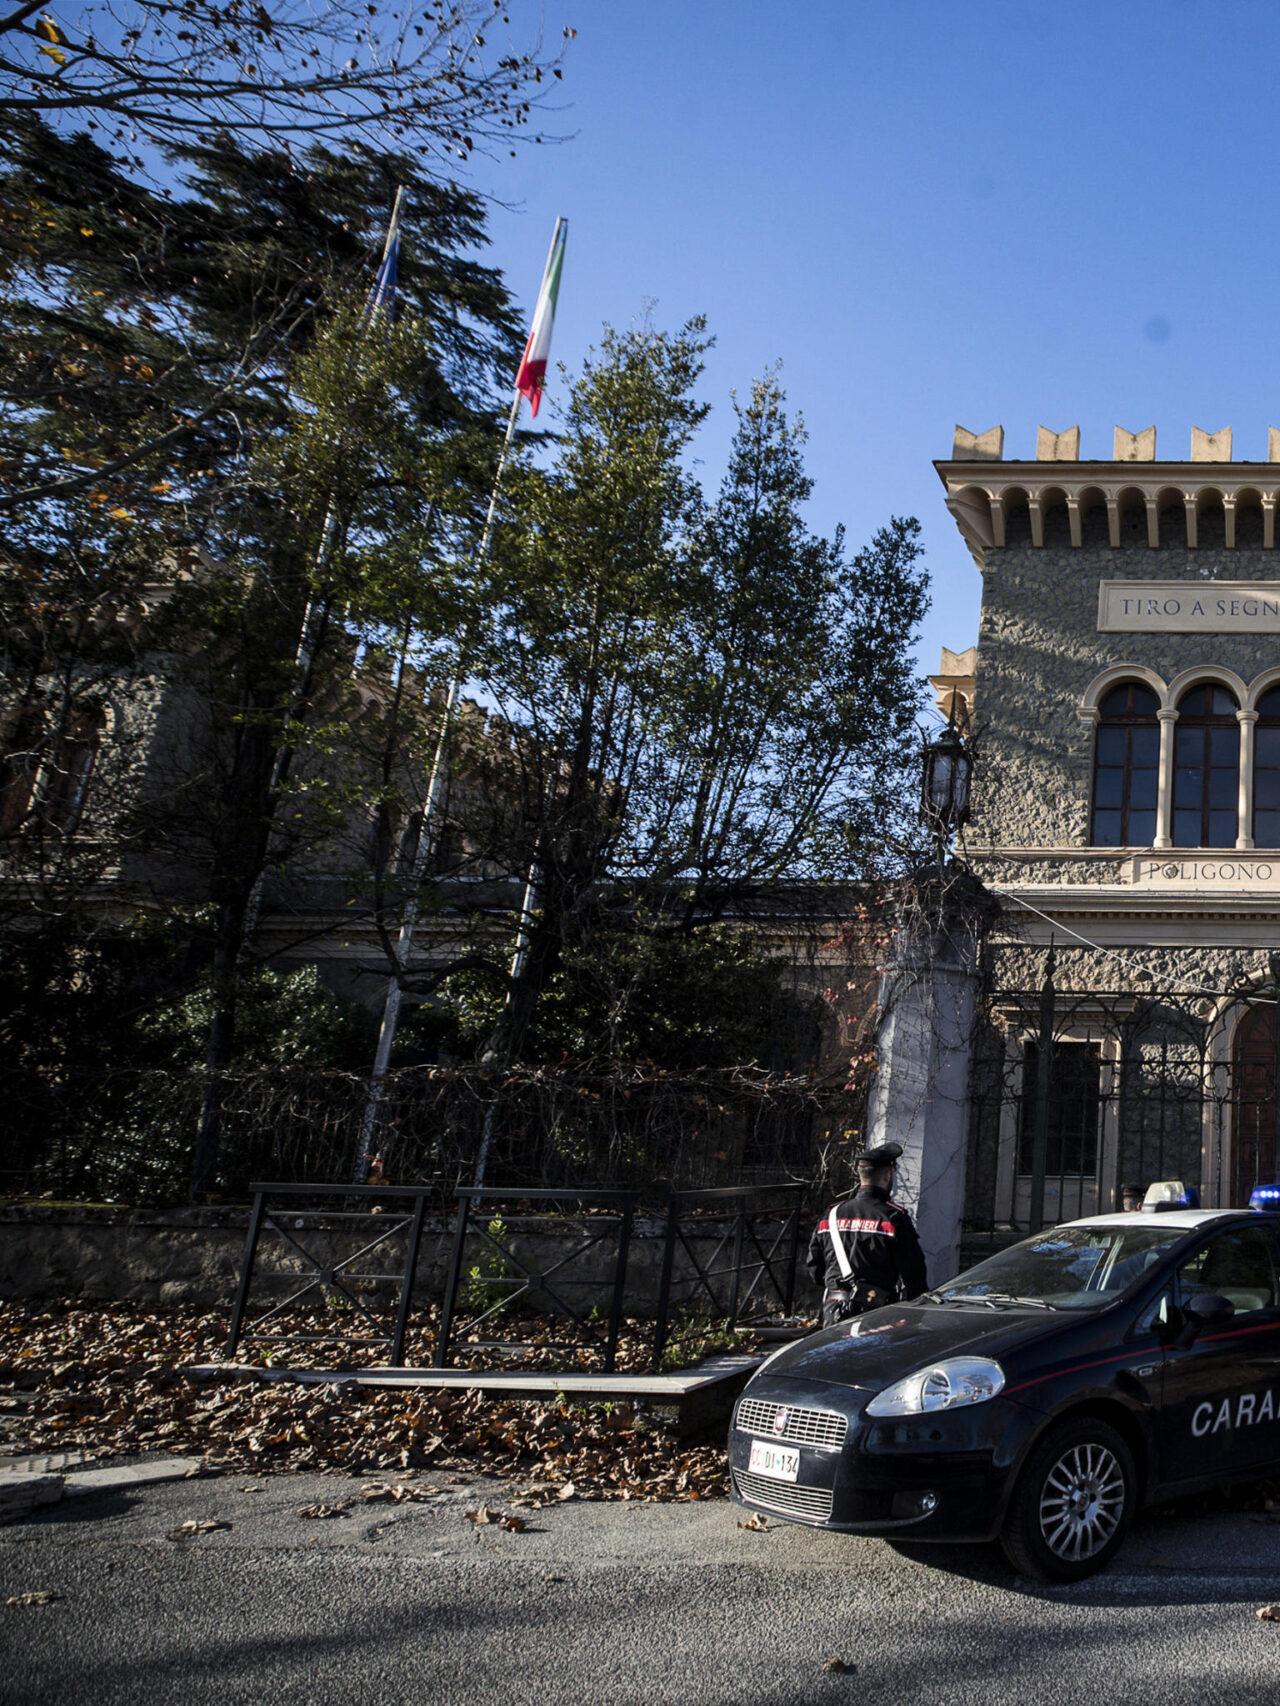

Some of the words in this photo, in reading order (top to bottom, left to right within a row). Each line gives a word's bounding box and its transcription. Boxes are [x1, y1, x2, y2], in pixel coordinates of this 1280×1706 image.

[1120, 599, 1182, 616] TIRO
[1191, 599, 1206, 616] A
[1149, 862, 1273, 881] POLIGONO
